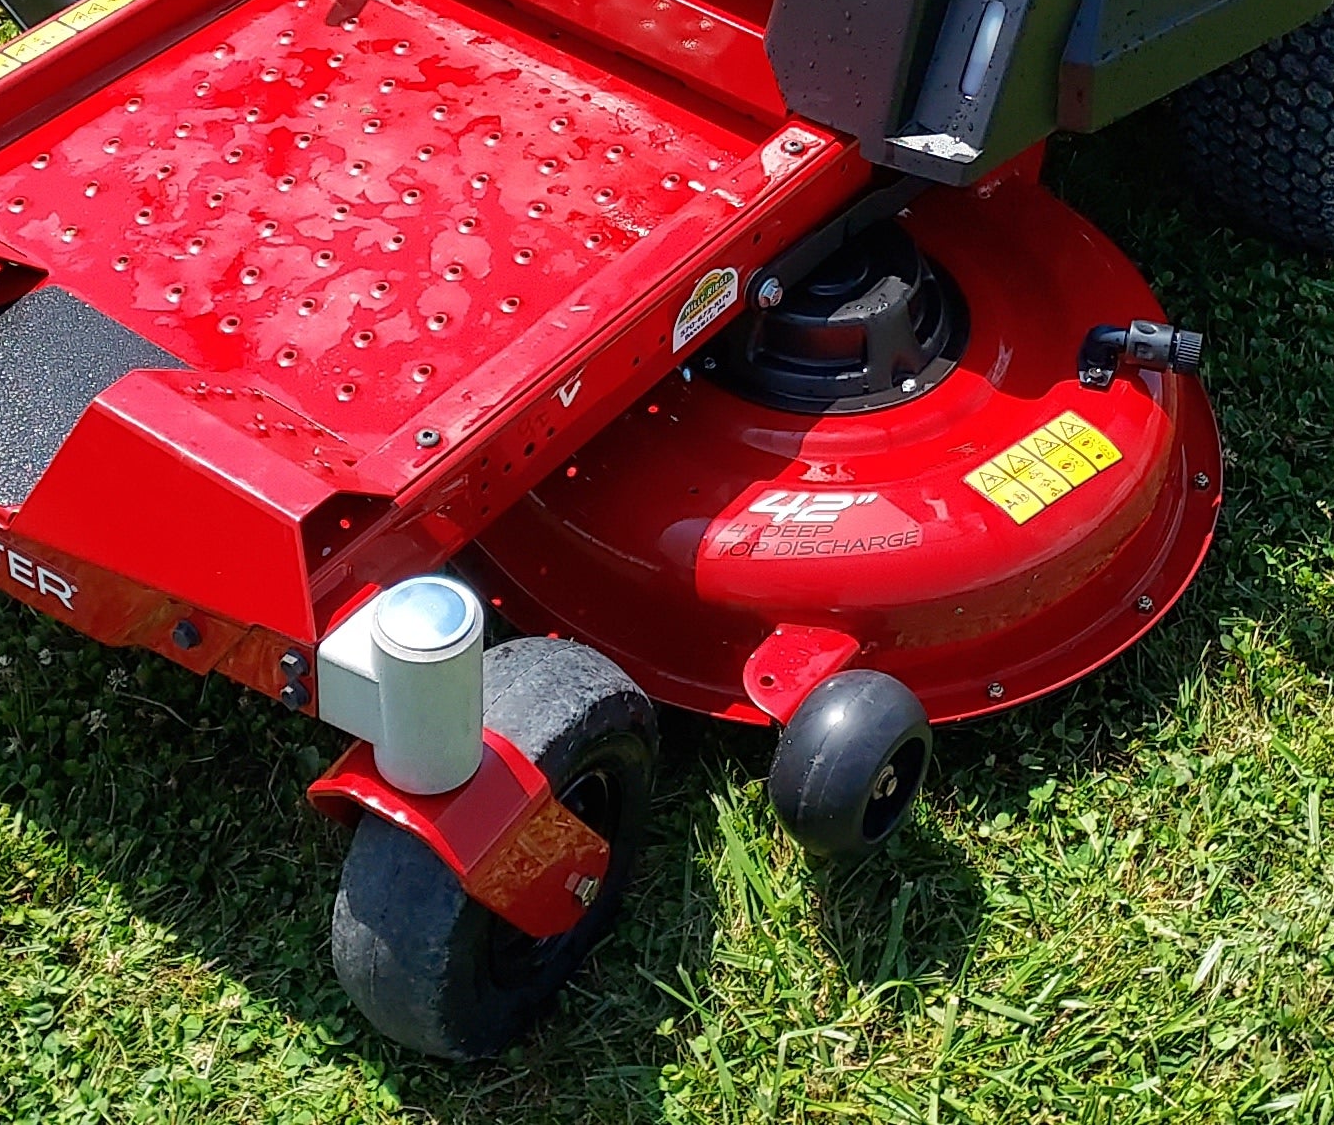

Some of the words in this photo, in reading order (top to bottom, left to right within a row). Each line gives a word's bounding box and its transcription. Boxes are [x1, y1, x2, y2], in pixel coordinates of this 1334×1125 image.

[762, 525, 834, 538] DEEP
[717, 540, 769, 557] TOP
[773, 528, 921, 557] DISCHARGE
